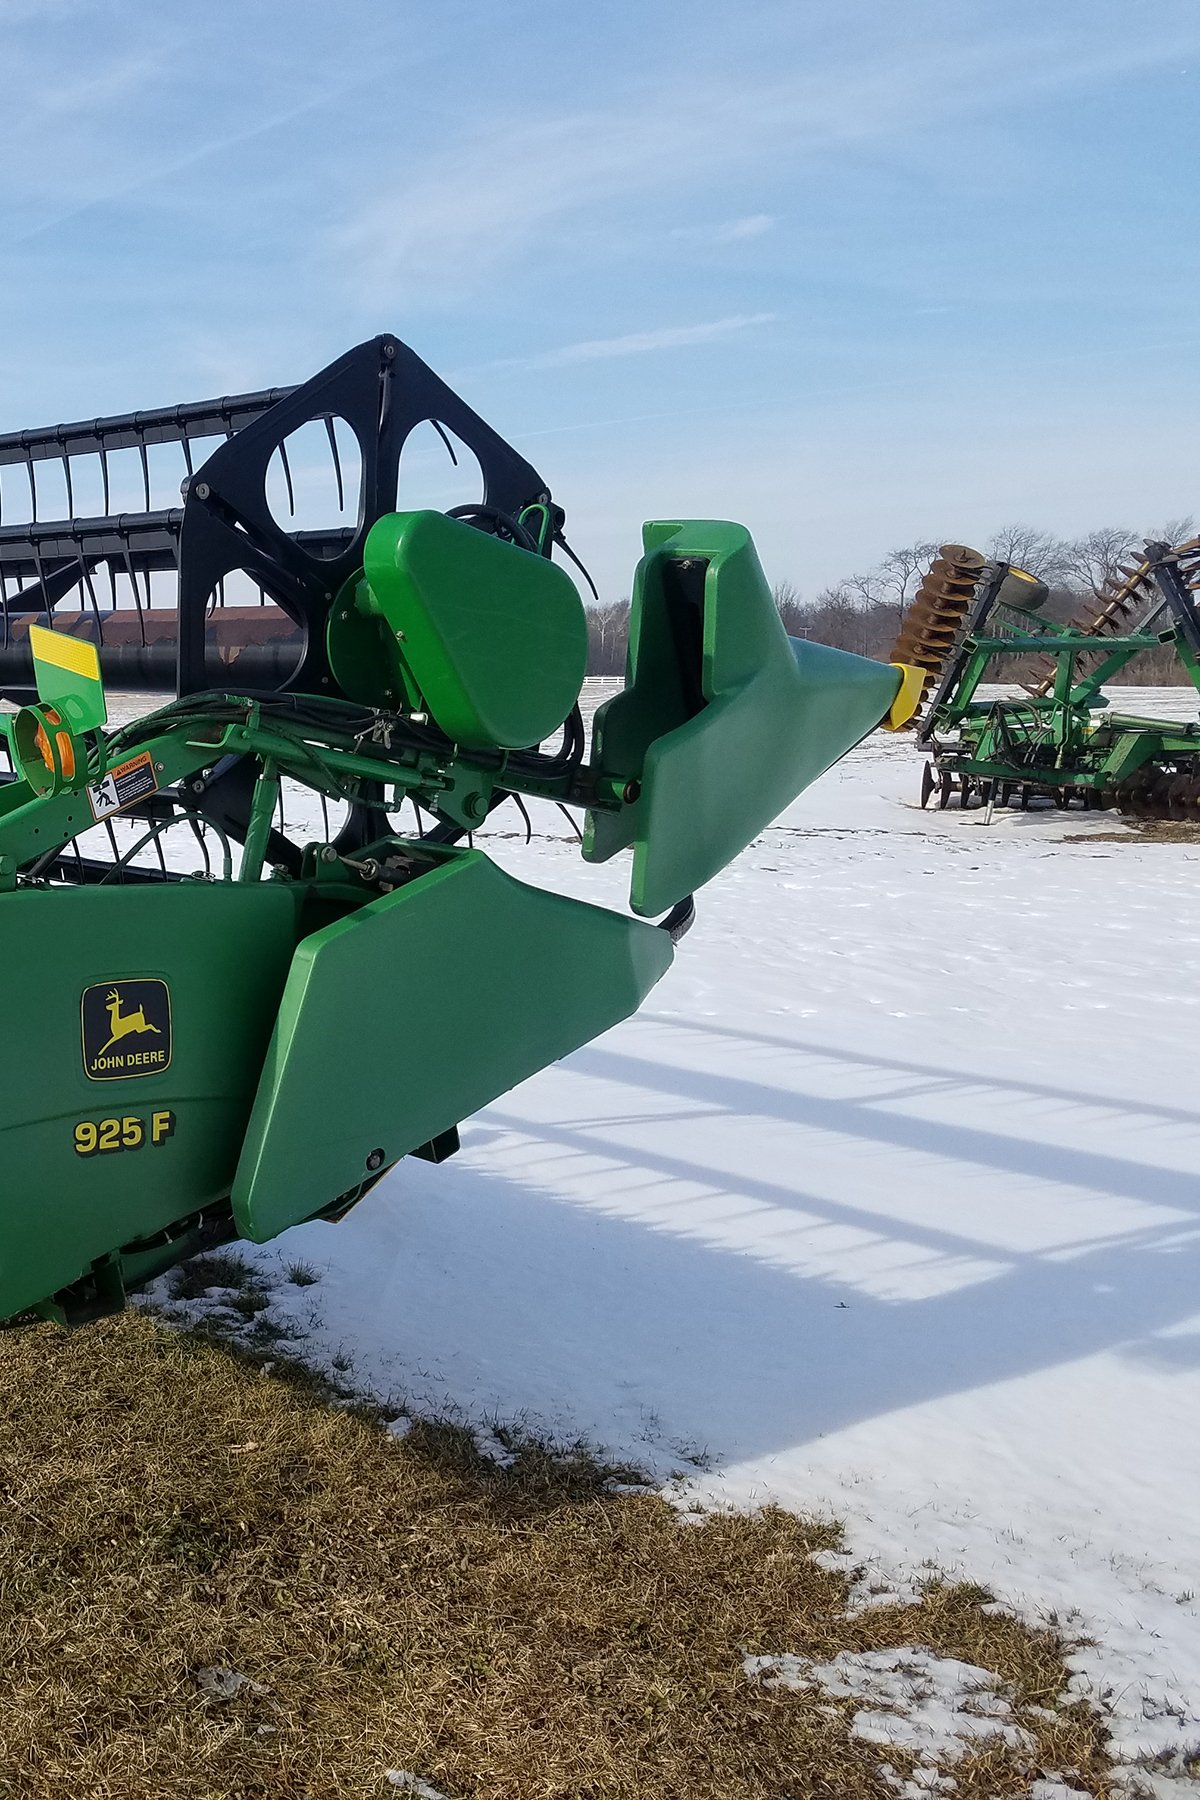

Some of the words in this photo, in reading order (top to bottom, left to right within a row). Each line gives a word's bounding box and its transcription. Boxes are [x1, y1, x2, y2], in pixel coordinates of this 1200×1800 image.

[120, 755, 147, 771] WARNING
[91, 1055, 124, 1071] JOHN
[127, 1050, 165, 1067] DEERE
[74, 1116, 144, 1155] 925
[152, 1110, 173, 1143] F
